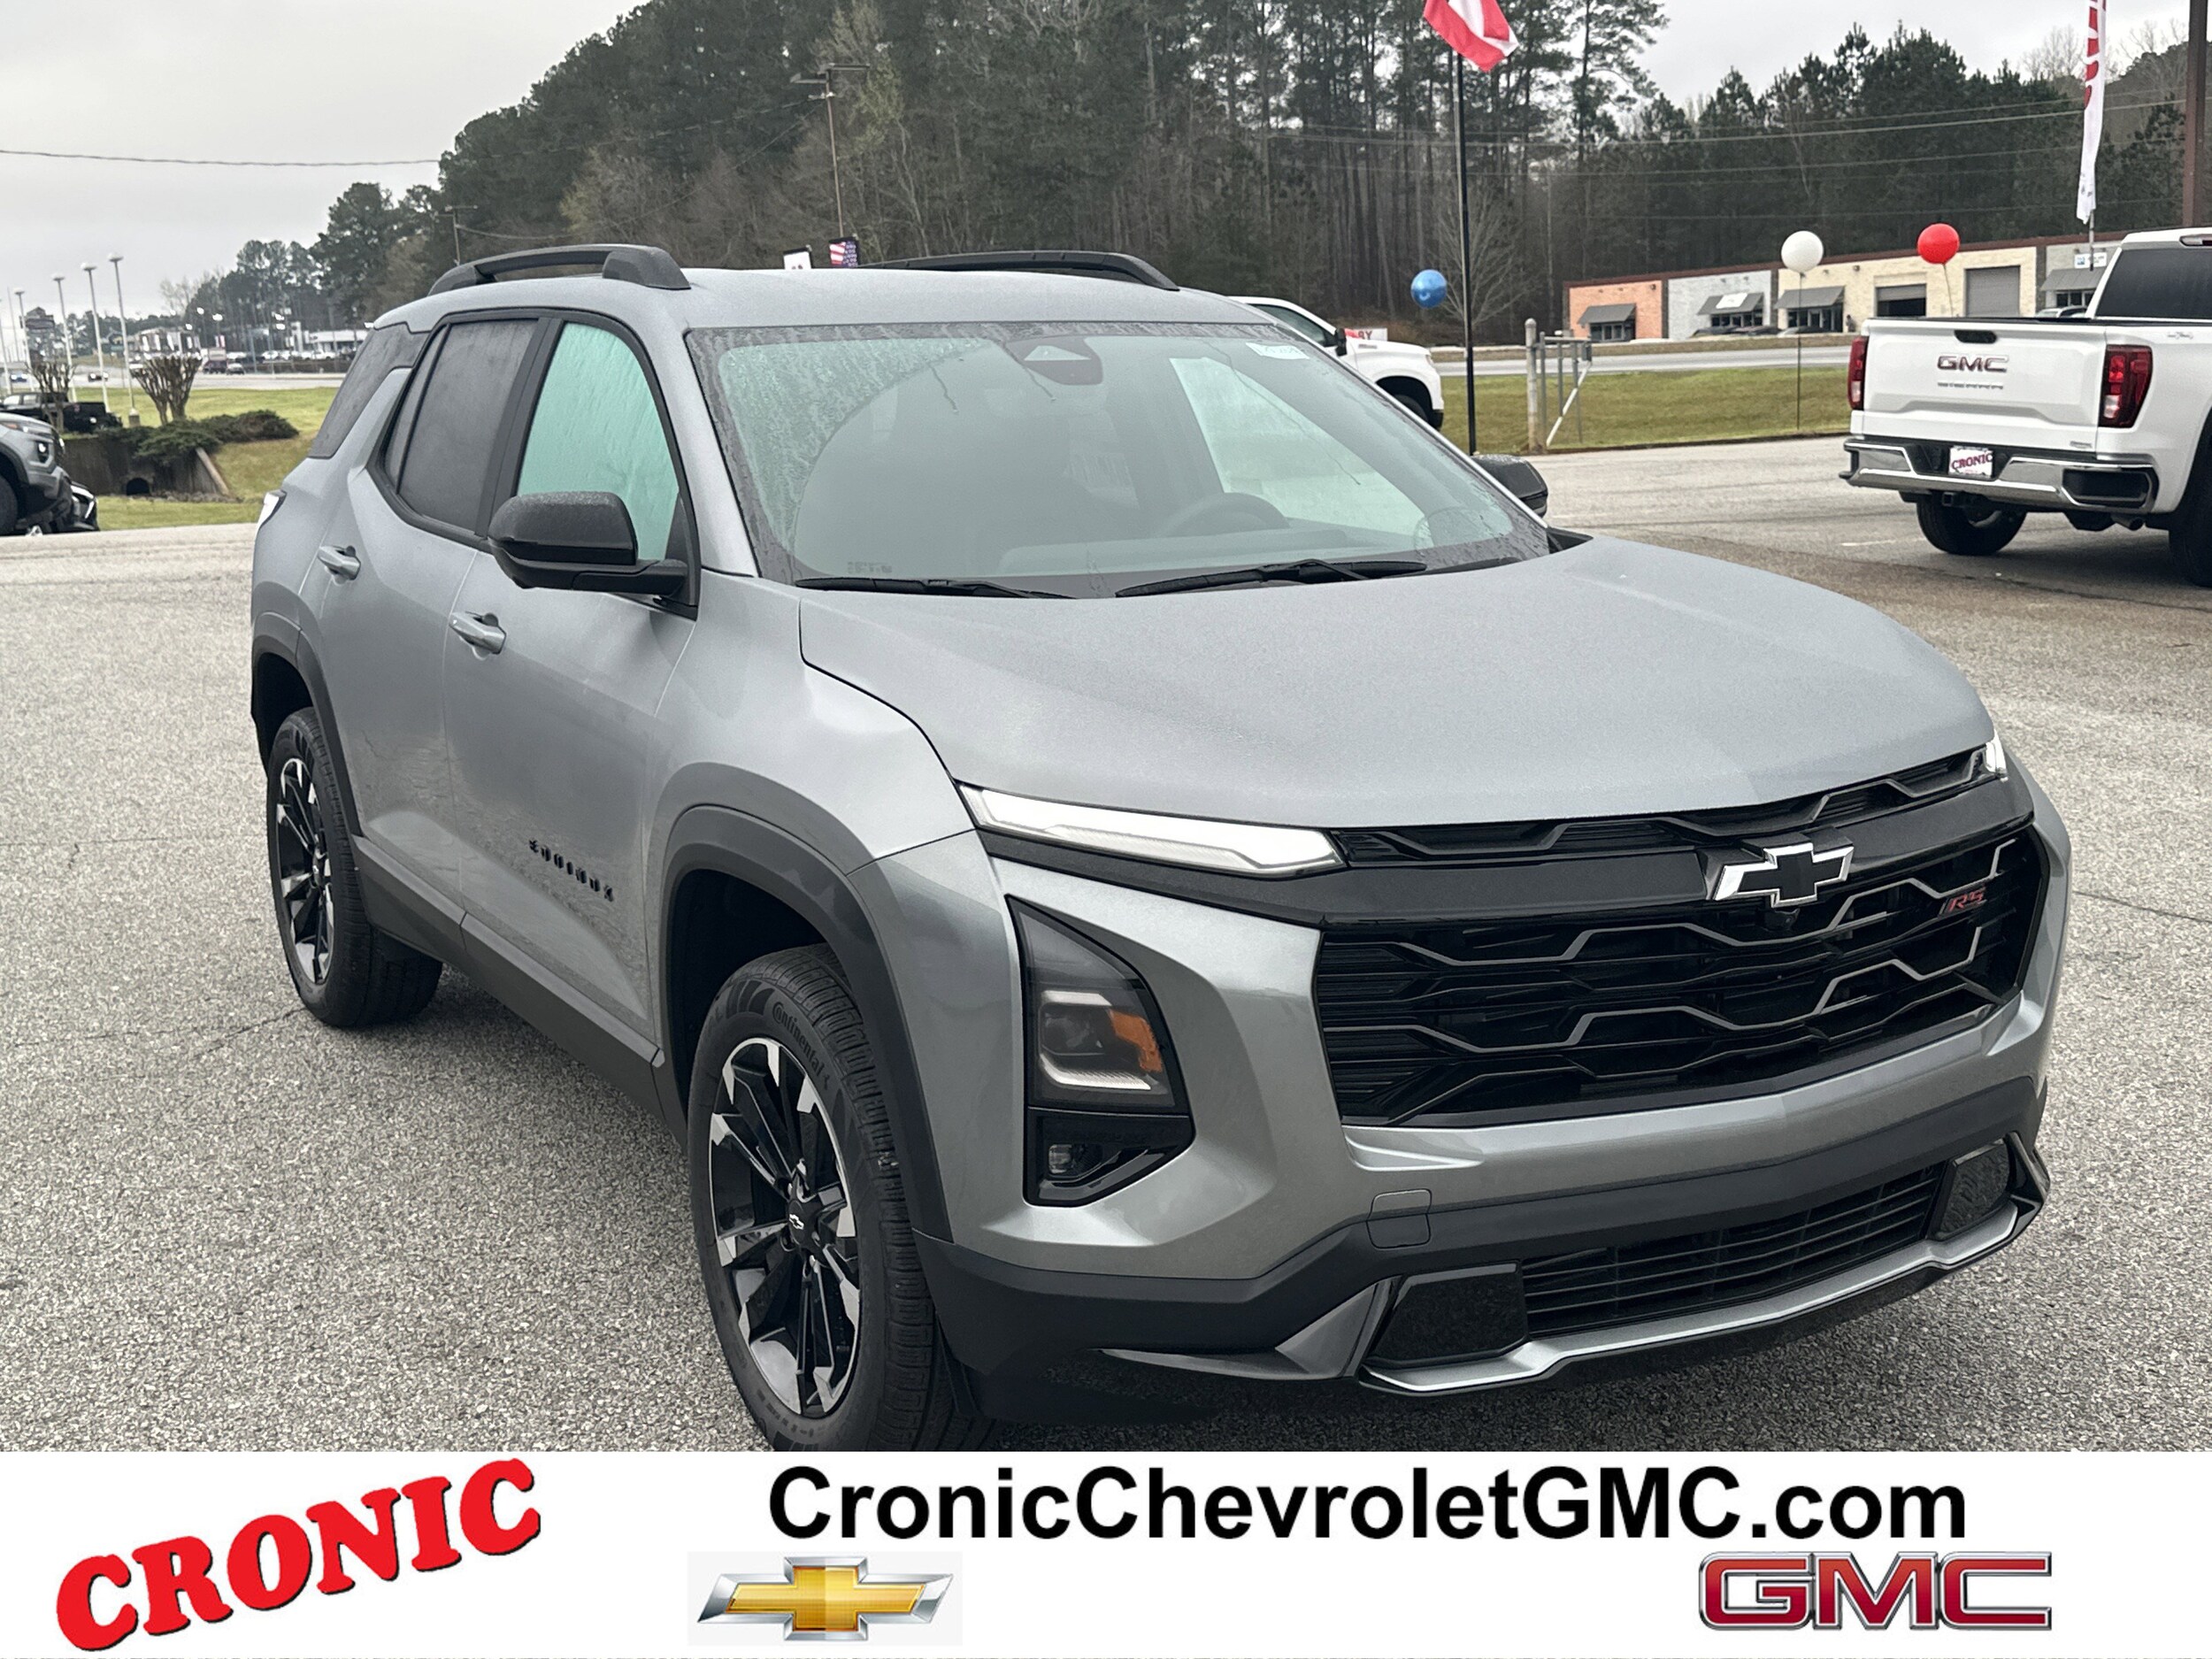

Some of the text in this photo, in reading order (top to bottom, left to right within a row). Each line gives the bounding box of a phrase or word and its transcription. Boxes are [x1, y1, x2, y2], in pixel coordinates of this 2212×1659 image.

[1937, 355, 2008, 373] GMC
[1952, 452, 1993, 471] CRONIC
[1947, 887, 1985, 912] RS
[772, 1001, 826, 1077] Continental
